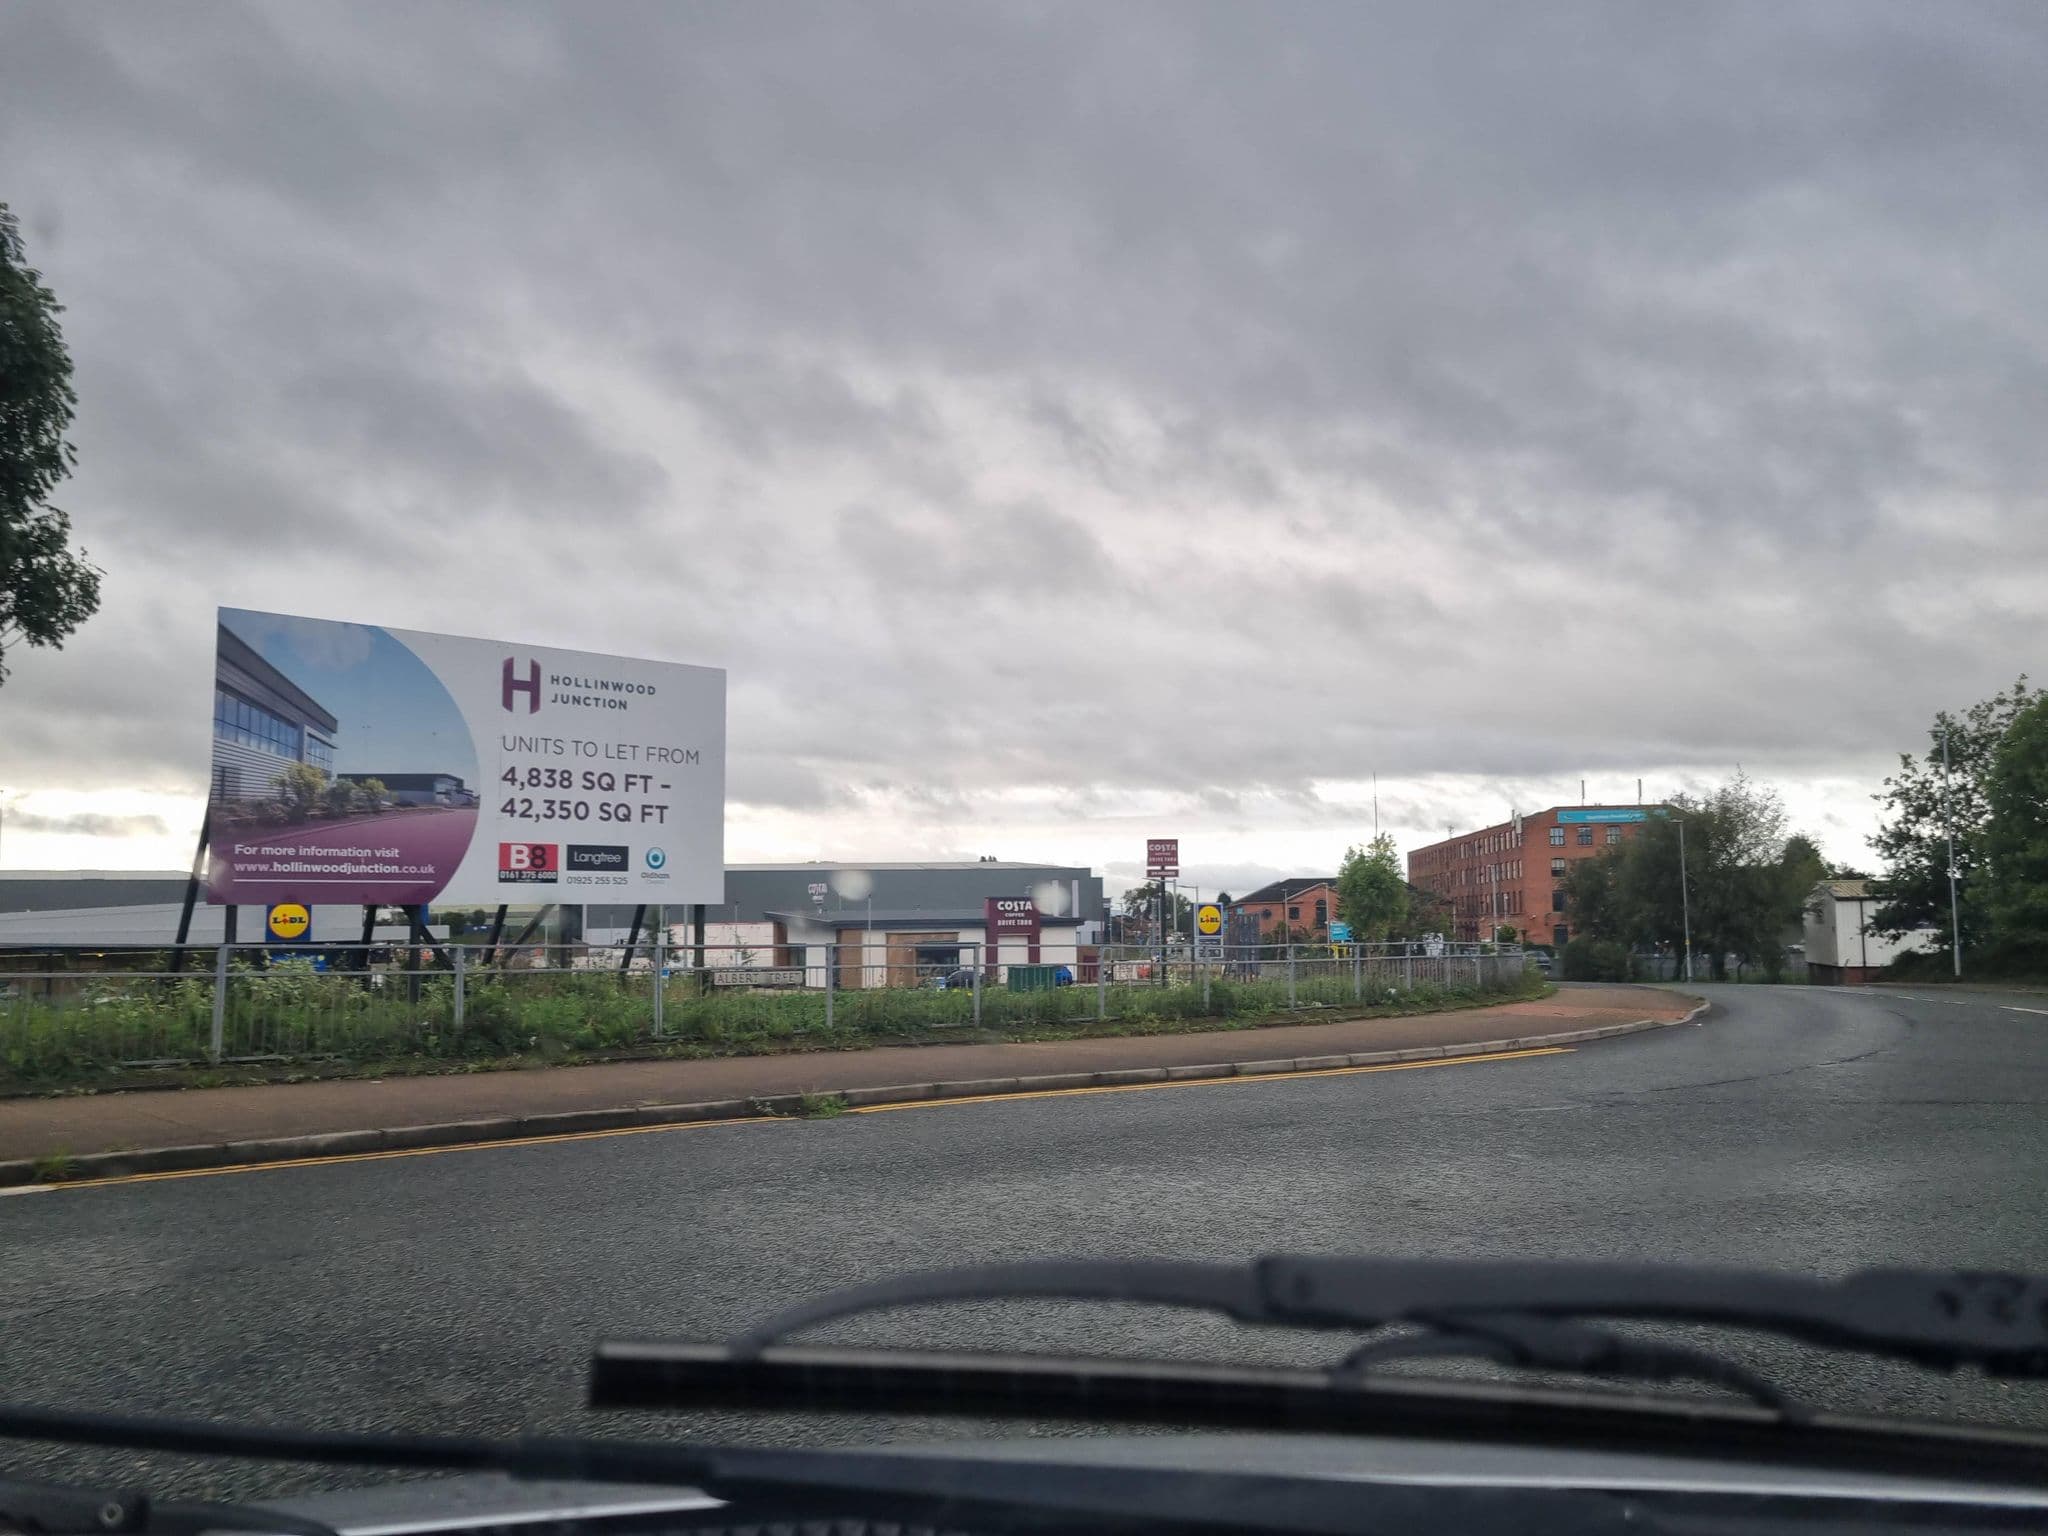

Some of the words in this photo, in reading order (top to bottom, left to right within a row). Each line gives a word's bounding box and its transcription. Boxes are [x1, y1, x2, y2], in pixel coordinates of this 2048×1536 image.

[551, 675, 656, 695] HOLLINWOOD
[551, 693, 628, 711] JUNCTION
[502, 735, 564, 755] UNITS
[571, 740, 598, 757] TO
[605, 743, 639, 760] LET
[646, 746, 699, 765] FROM
[501, 766, 573, 791] 4,838
[582, 771, 615, 792] SQ
[624, 774, 653, 793] FT
[500, 798, 590, 822] 42,350
[598, 802, 632, 822] SQ
[641, 804, 669, 824] FT
[234, 844, 257, 855] For
[261, 846, 296, 856] more
[299, 845, 371, 858] information
[374, 847, 400, 858] visit
[1149, 844, 1176, 852] COSTA
[510, 845, 547, 869] B8
[573, 850, 622, 866] Langtree
[234, 861, 435, 875] www.hollinwoodjunction.co.uk
[500, 870, 520, 880] 0161
[567, 876, 592, 885] 01925
[612, 877, 629, 886] 525
[997, 900, 1033, 911] COSTA
[717, 973, 759, 984] ALBERT
